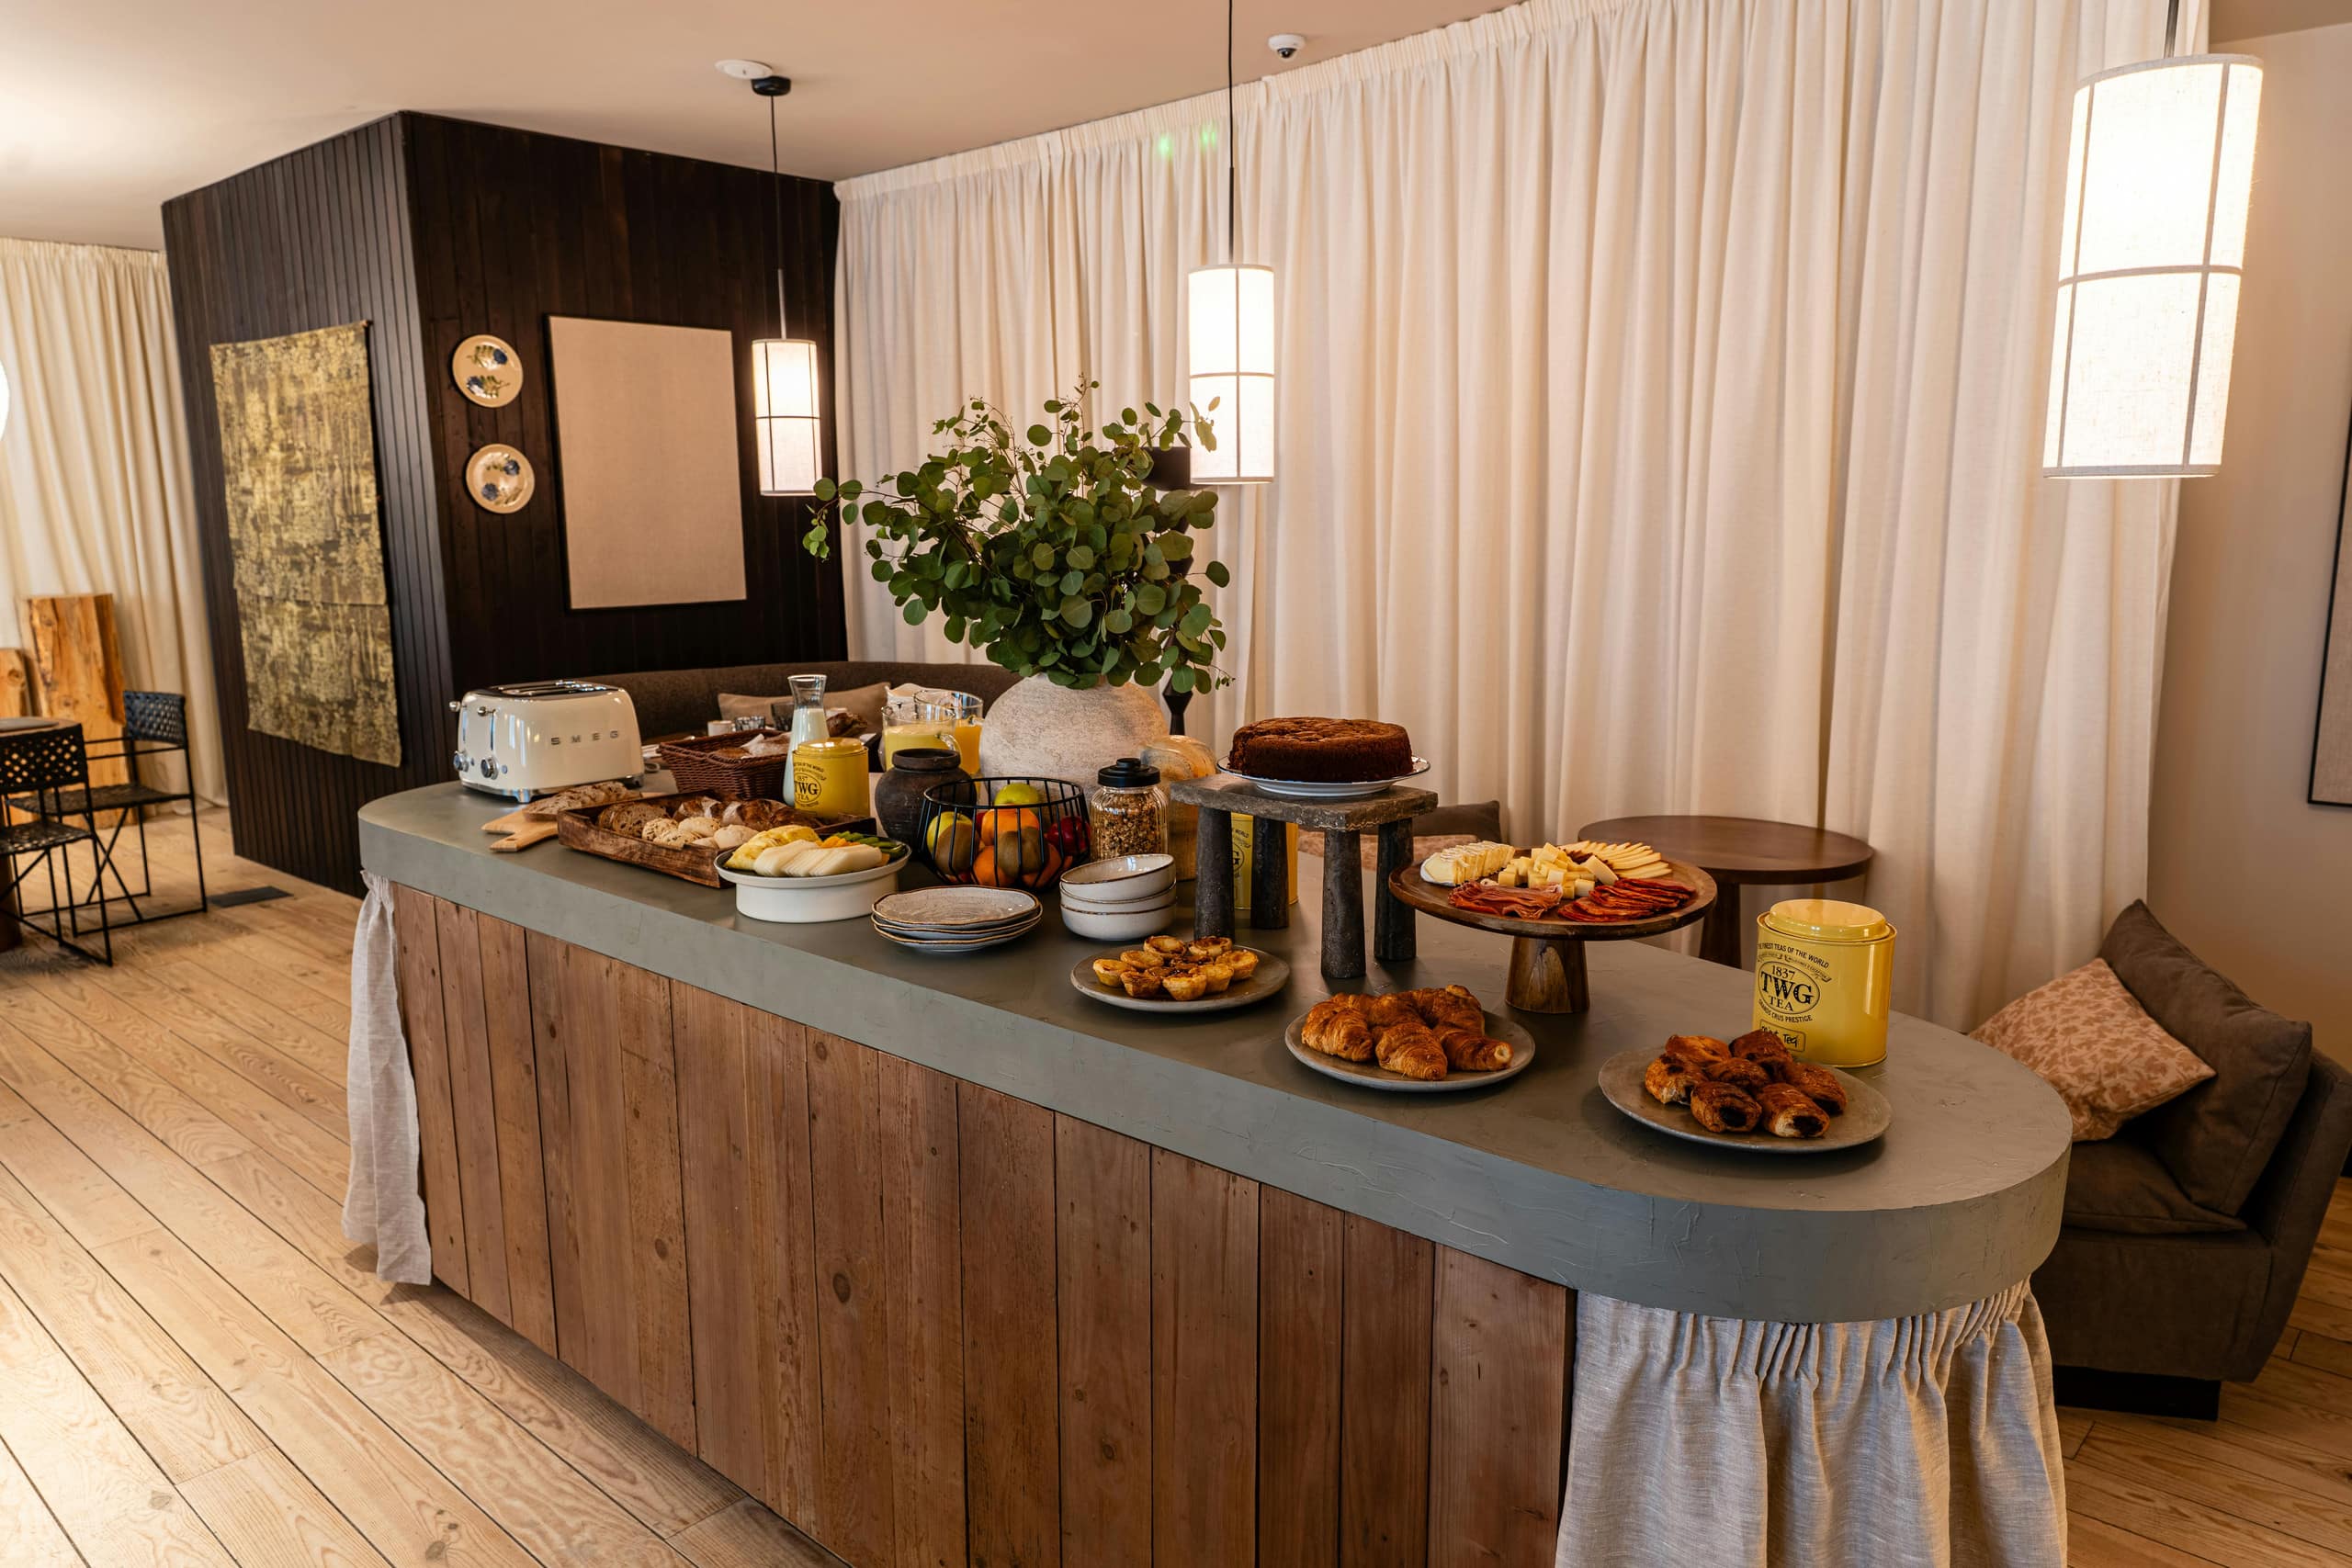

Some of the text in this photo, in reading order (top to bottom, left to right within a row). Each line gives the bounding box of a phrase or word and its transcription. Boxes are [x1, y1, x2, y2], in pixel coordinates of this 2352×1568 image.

[550, 730, 619, 746] SMEG
[1774, 943, 1787, 952] TEAS
[1795, 949, 1807, 959] THE
[1808, 954, 1829, 969] WORLD
[1771, 964, 1796, 980] 1837
[1760, 971, 1815, 1005] TWG
[1768, 996, 1793, 1011] TEA
[1771, 1012, 1784, 1022] CRUS
[1784, 1014, 1813, 1023] PRESTIGE
[1782, 1033, 1799, 1048] Tea
